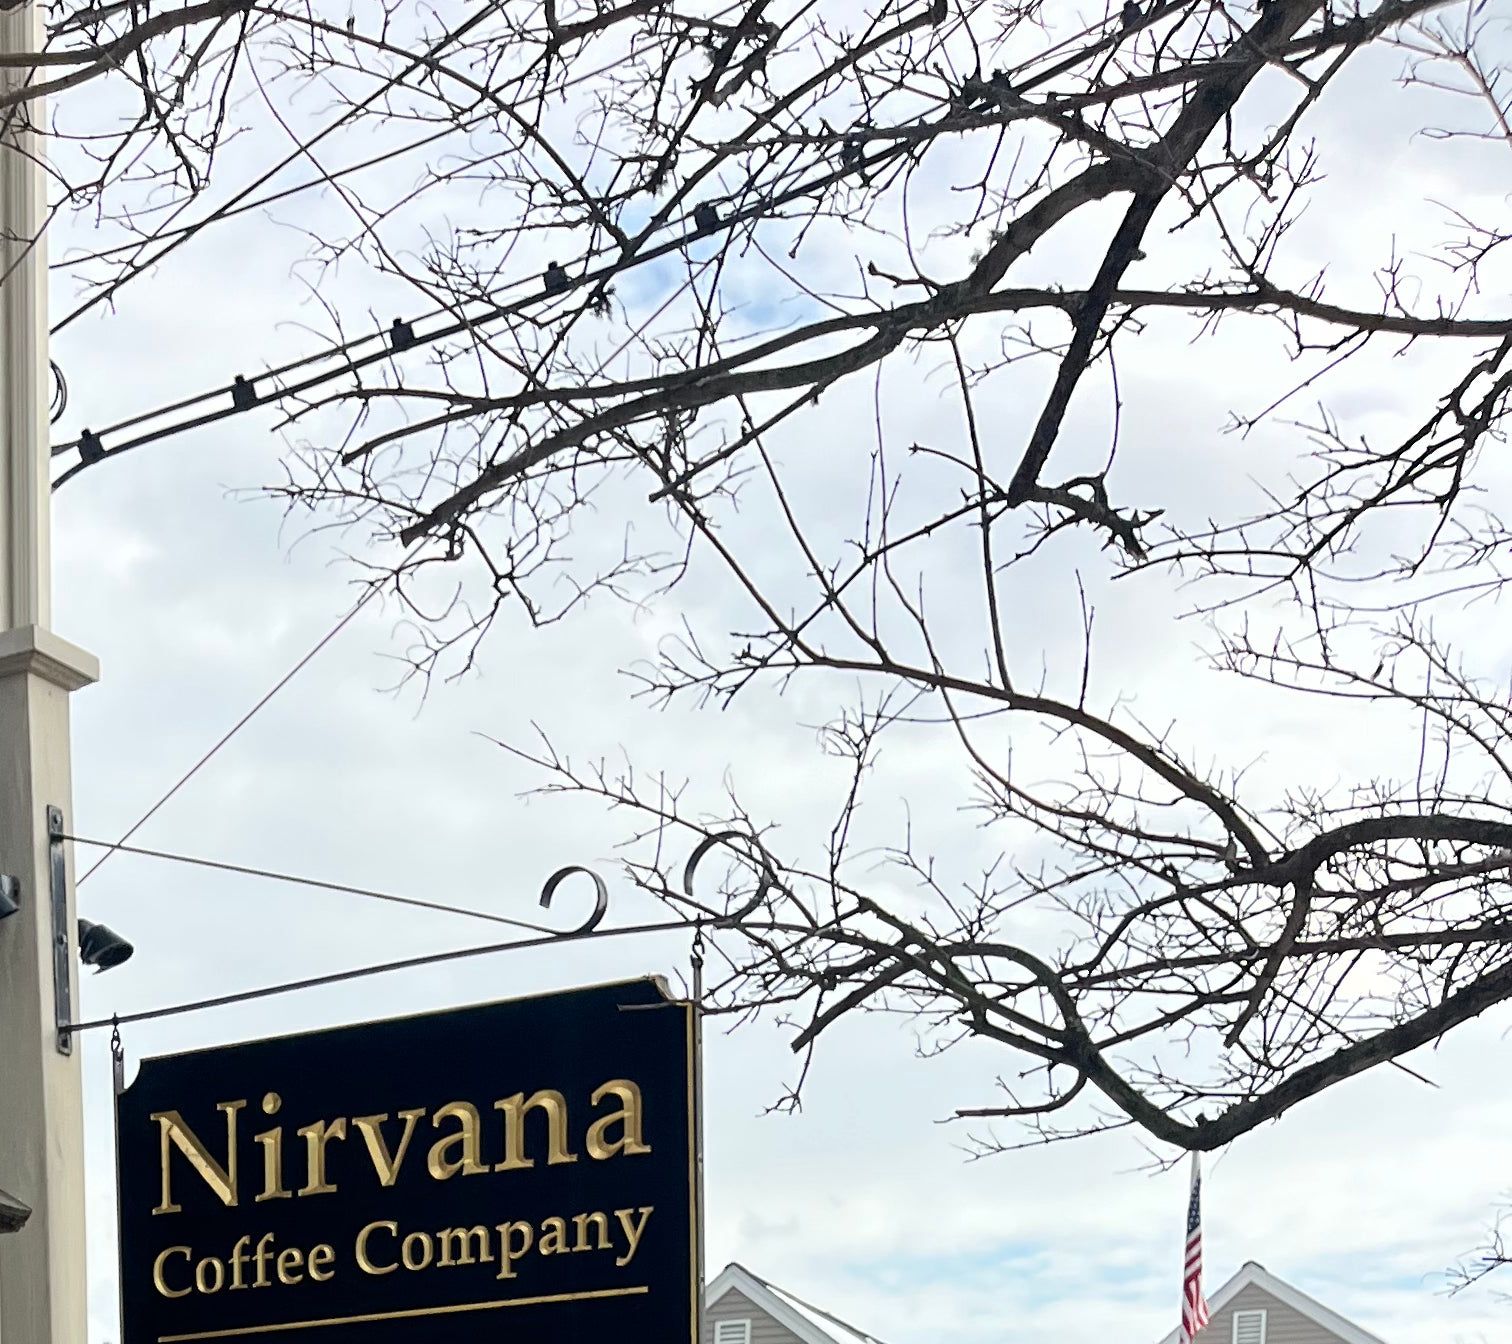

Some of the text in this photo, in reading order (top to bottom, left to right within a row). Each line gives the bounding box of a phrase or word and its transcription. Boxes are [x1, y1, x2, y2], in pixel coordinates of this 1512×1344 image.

[150, 1078, 652, 1216] Nirvana
[152, 1206, 654, 1298] Coffee Company
